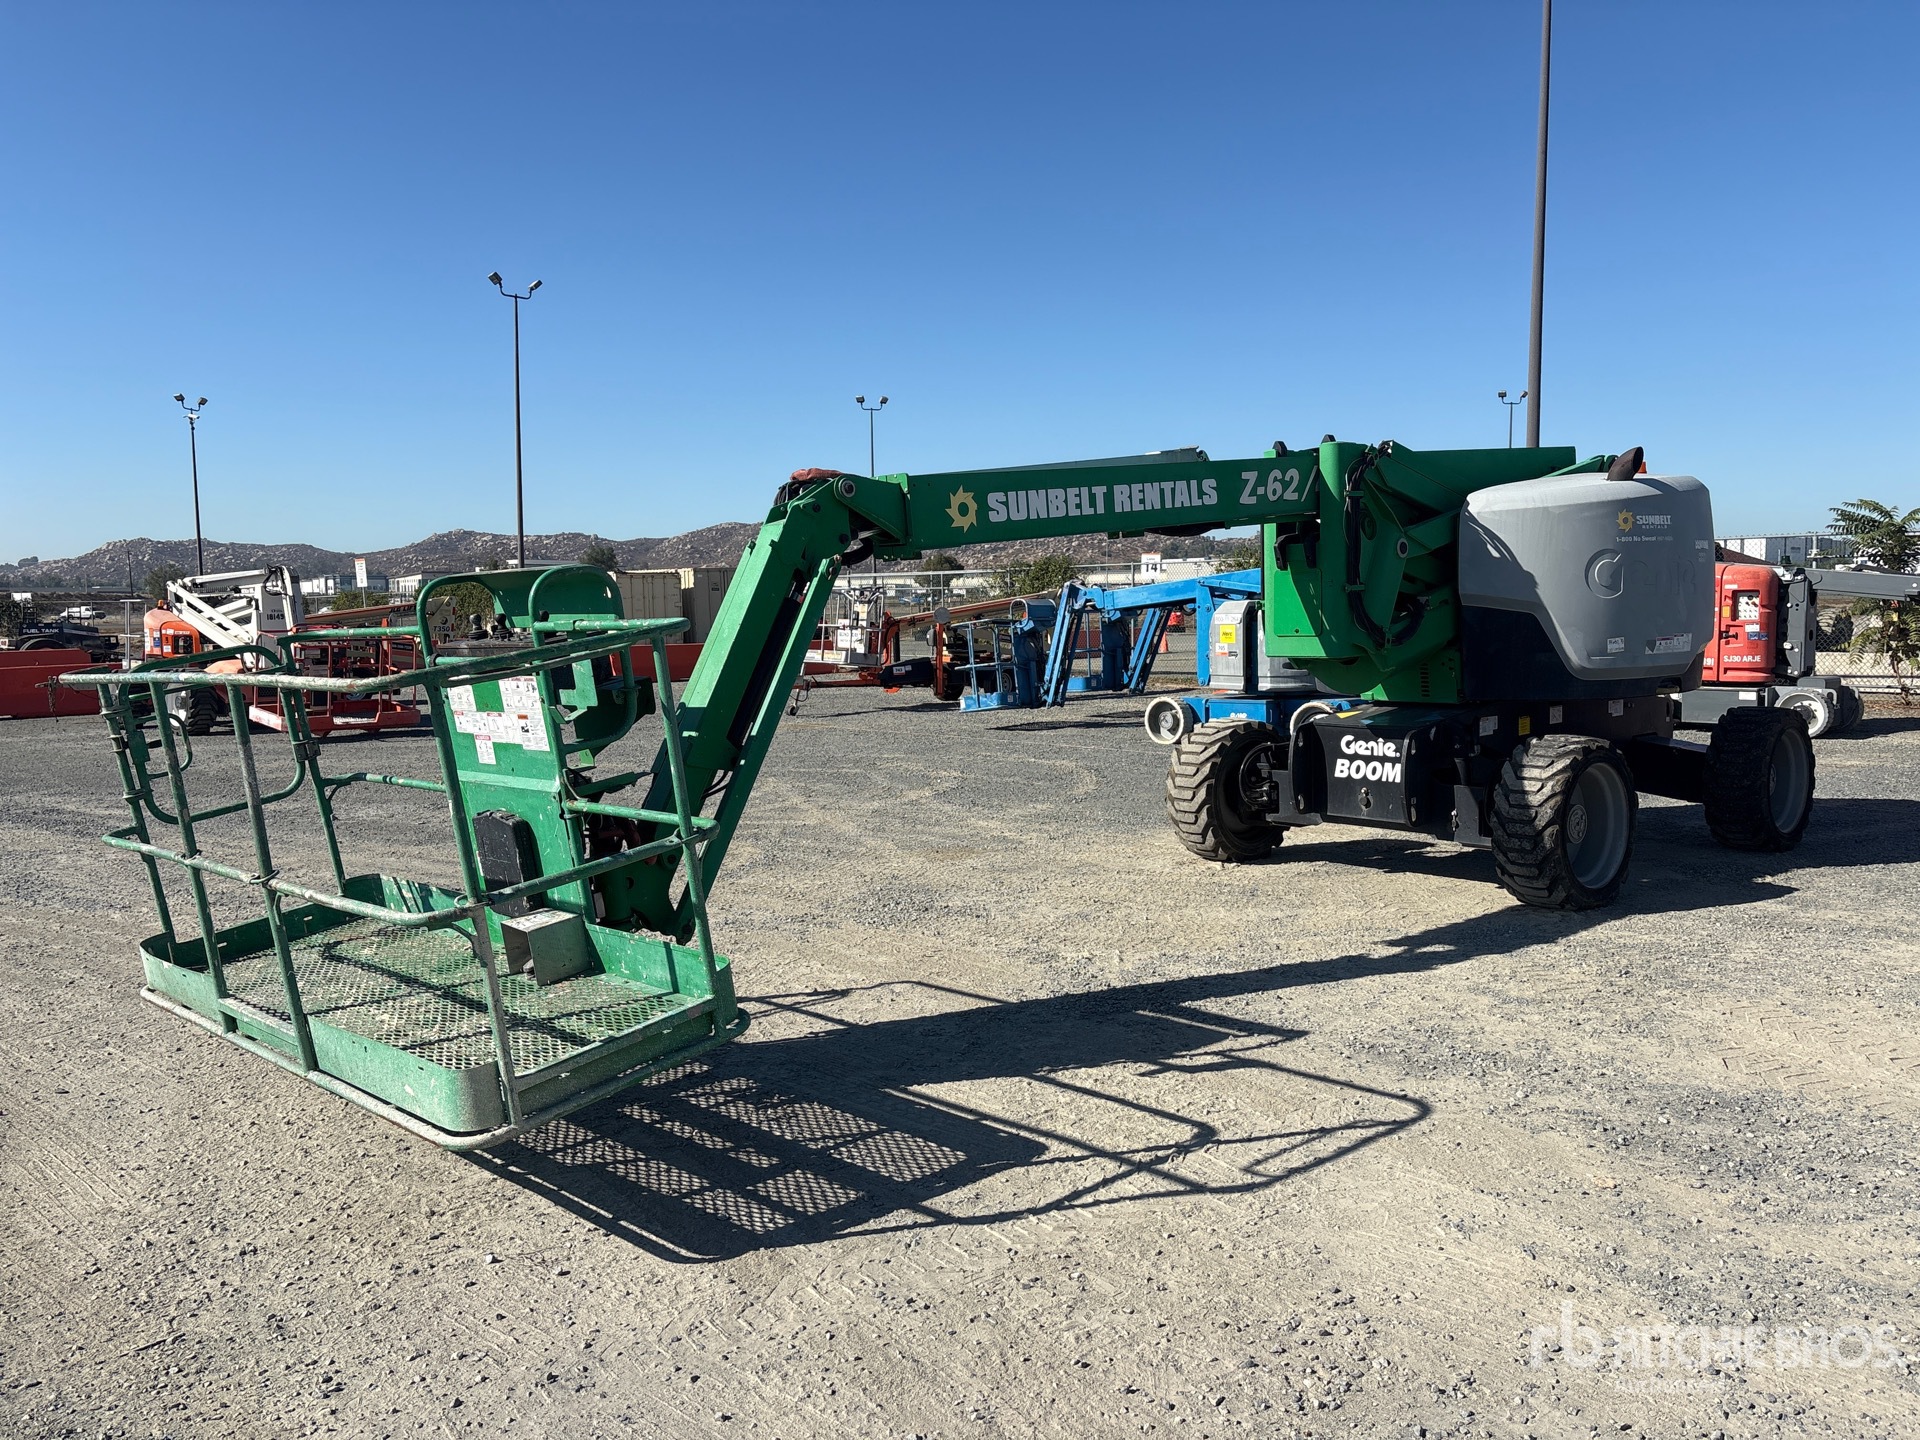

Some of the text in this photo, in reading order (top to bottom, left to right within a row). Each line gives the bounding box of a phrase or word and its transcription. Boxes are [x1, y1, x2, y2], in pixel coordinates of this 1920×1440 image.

[987, 478, 1218, 523] SUNBELT RENTALS
[1636, 515, 1671, 524] SUNBELT
[1723, 655, 1762, 663] SJ30 ARJE
[1334, 758, 1402, 783] BOOM
